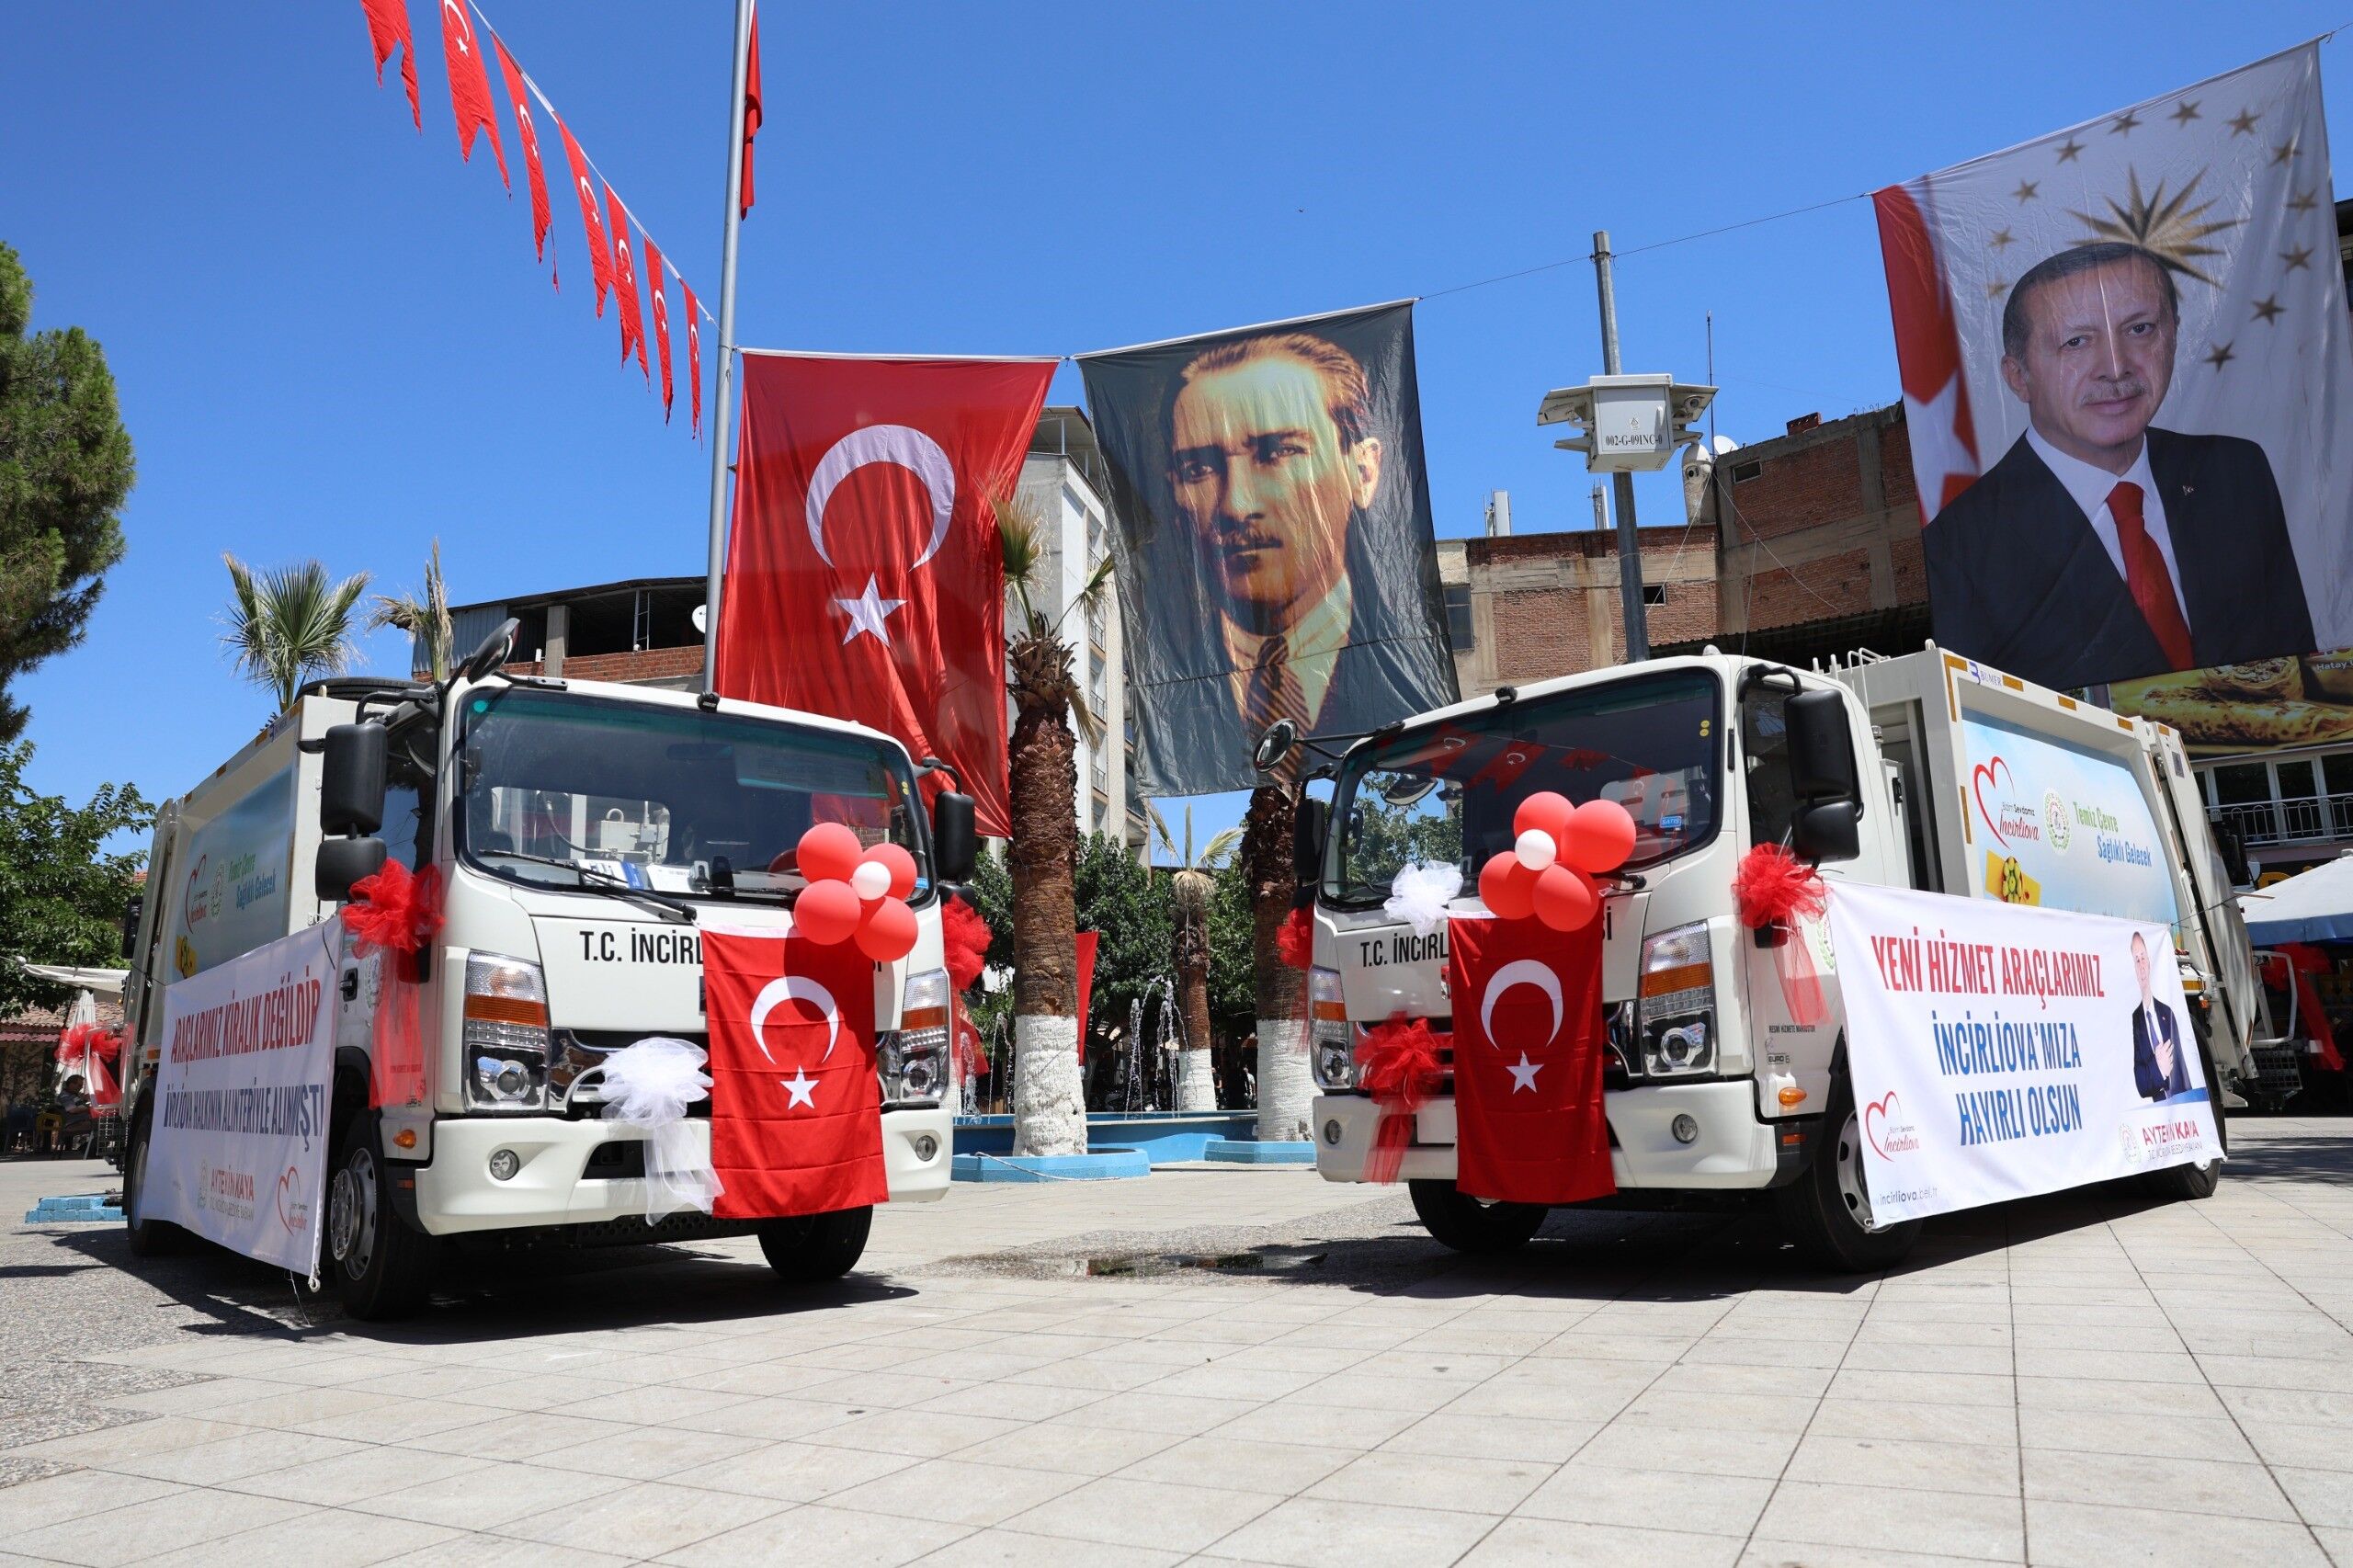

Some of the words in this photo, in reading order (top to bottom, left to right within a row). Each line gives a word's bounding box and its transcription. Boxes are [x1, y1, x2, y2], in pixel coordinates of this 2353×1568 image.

[2317, 662, 2347, 670] Hatay
[2073, 801, 2097, 827] Temiz
[2097, 807, 2118, 835] Çevre
[2097, 835, 2124, 863] Sağlıklı
[2125, 841, 2152, 867] Gelecek
[579, 930, 622, 962] T.C.
[1360, 939, 1388, 967] T.C.
[1870, 926, 1923, 992] YENİ
[1927, 929, 1995, 994] HİZMET
[2001, 947, 2105, 1010] ARAÇLARIMIZ
[171, 1006, 223, 1076] ARAÇLARIMIZ
[223, 989, 262, 1056] KİRALIK
[262, 965, 321, 1051] DEĞİLDİR
[1931, 1010, 2083, 1075] İNCİRLİOVA'MIZA
[1955, 1088, 2026, 1145] HAYIRLI
[2028, 1084, 2083, 1137] OLSUN
